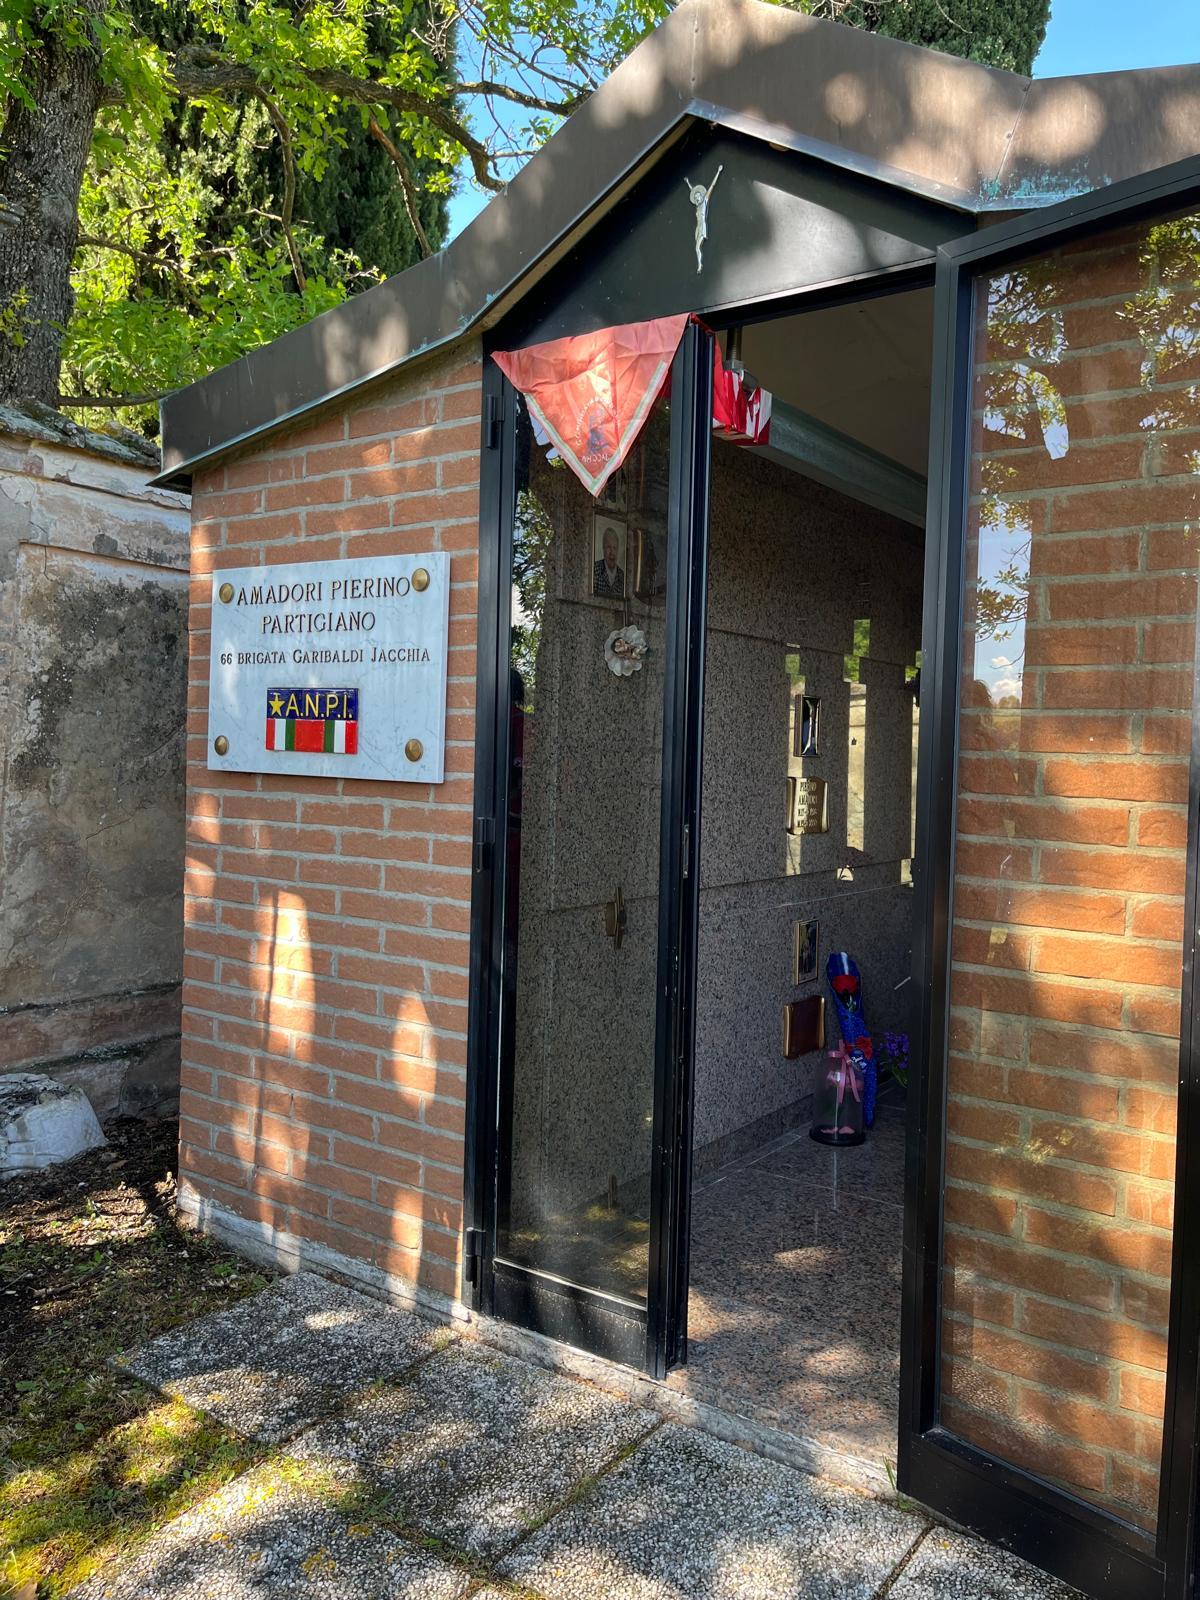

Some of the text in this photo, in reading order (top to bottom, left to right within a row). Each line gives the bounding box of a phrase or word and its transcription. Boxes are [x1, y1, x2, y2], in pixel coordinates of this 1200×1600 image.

[236, 575, 411, 606] AMADORI PIERINO
[261, 611, 376, 634] PARTIGIANO
[220, 646, 430, 665] 66 BRIGATA GARIBALDI JACCHIA
[285, 692, 353, 719] A.N.P.I.
